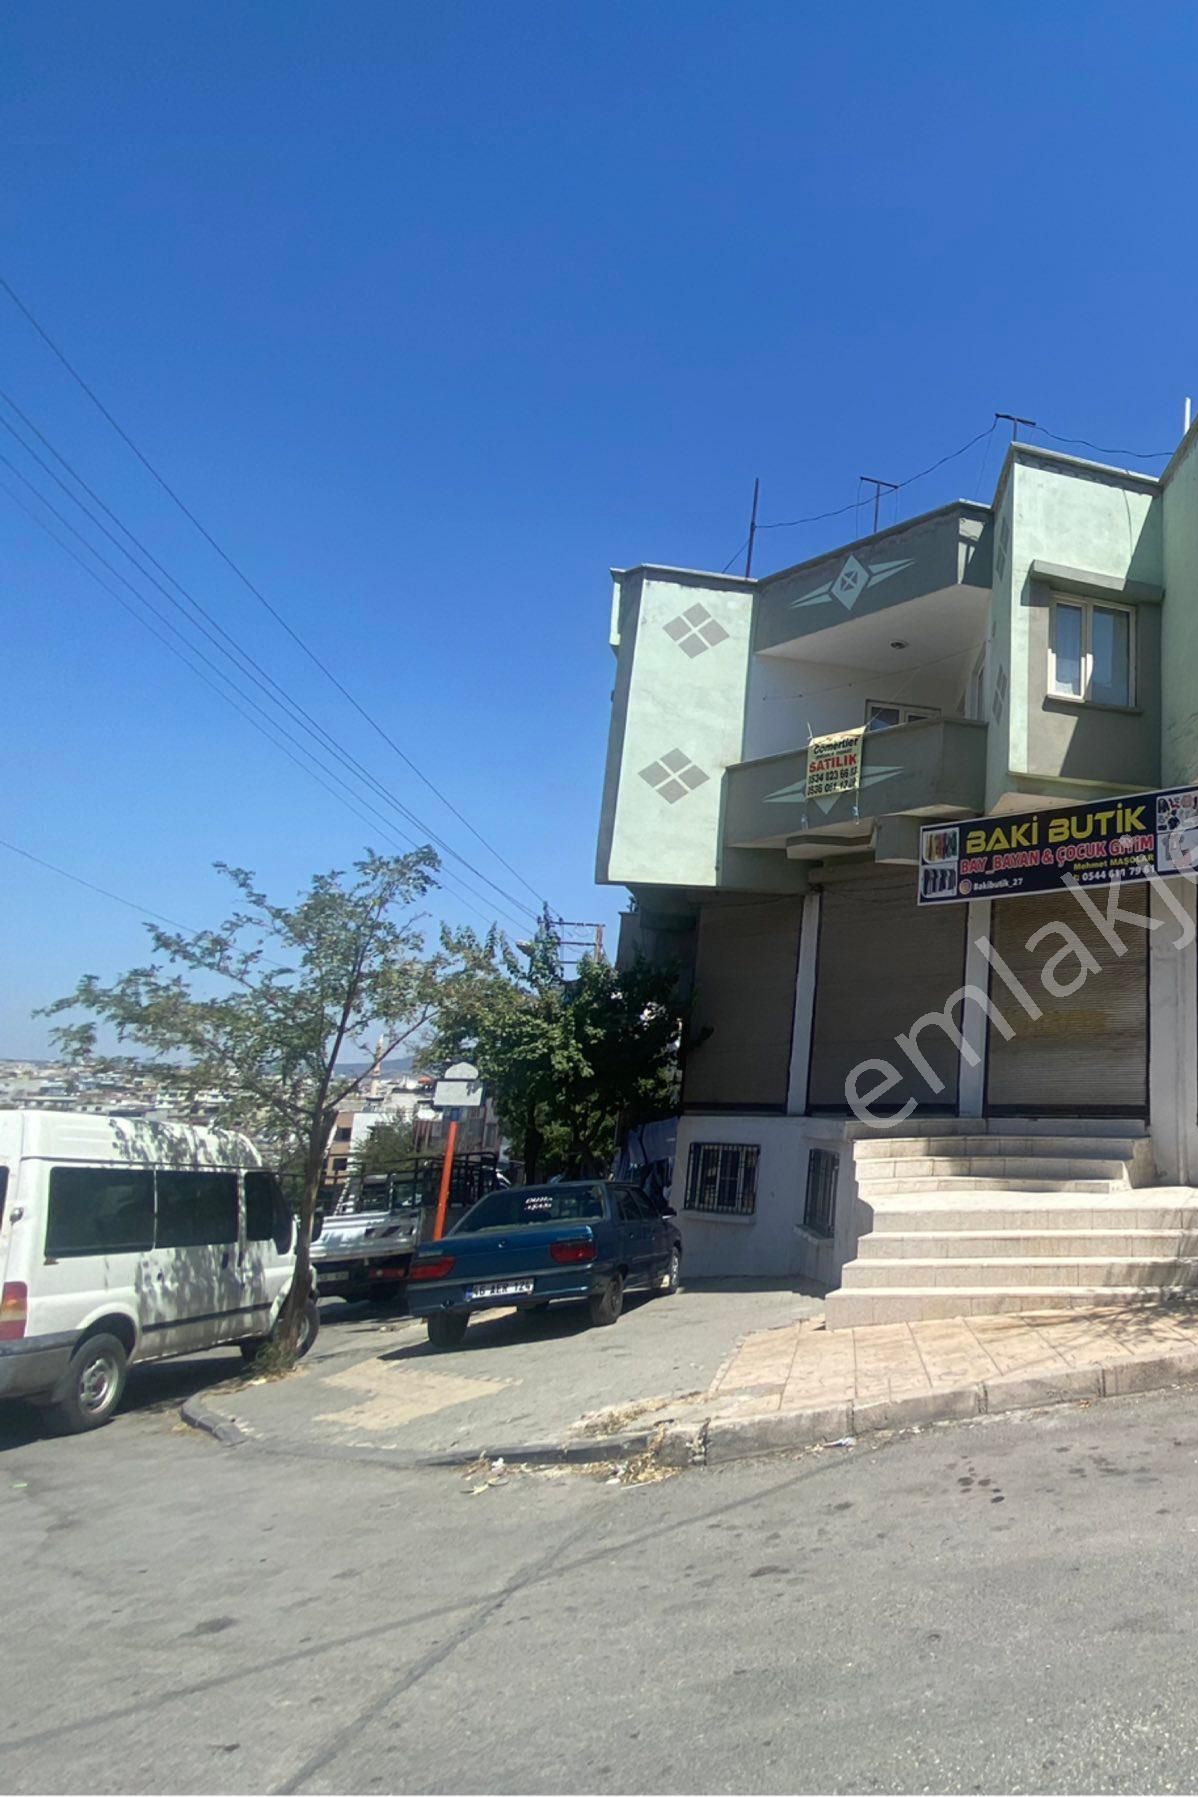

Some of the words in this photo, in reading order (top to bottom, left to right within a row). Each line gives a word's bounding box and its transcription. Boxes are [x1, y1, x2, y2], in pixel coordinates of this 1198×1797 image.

[808, 753, 858, 773] SATILIK
[966, 815, 1038, 854] BAKİ
[1048, 803, 1147, 843] BUTİK
[1042, 847, 1054, 865] &
[1056, 841, 1107, 868] ÇOCUK
[1073, 860, 1108, 871] Mehmet
[1081, 870, 1107, 881] 0544
